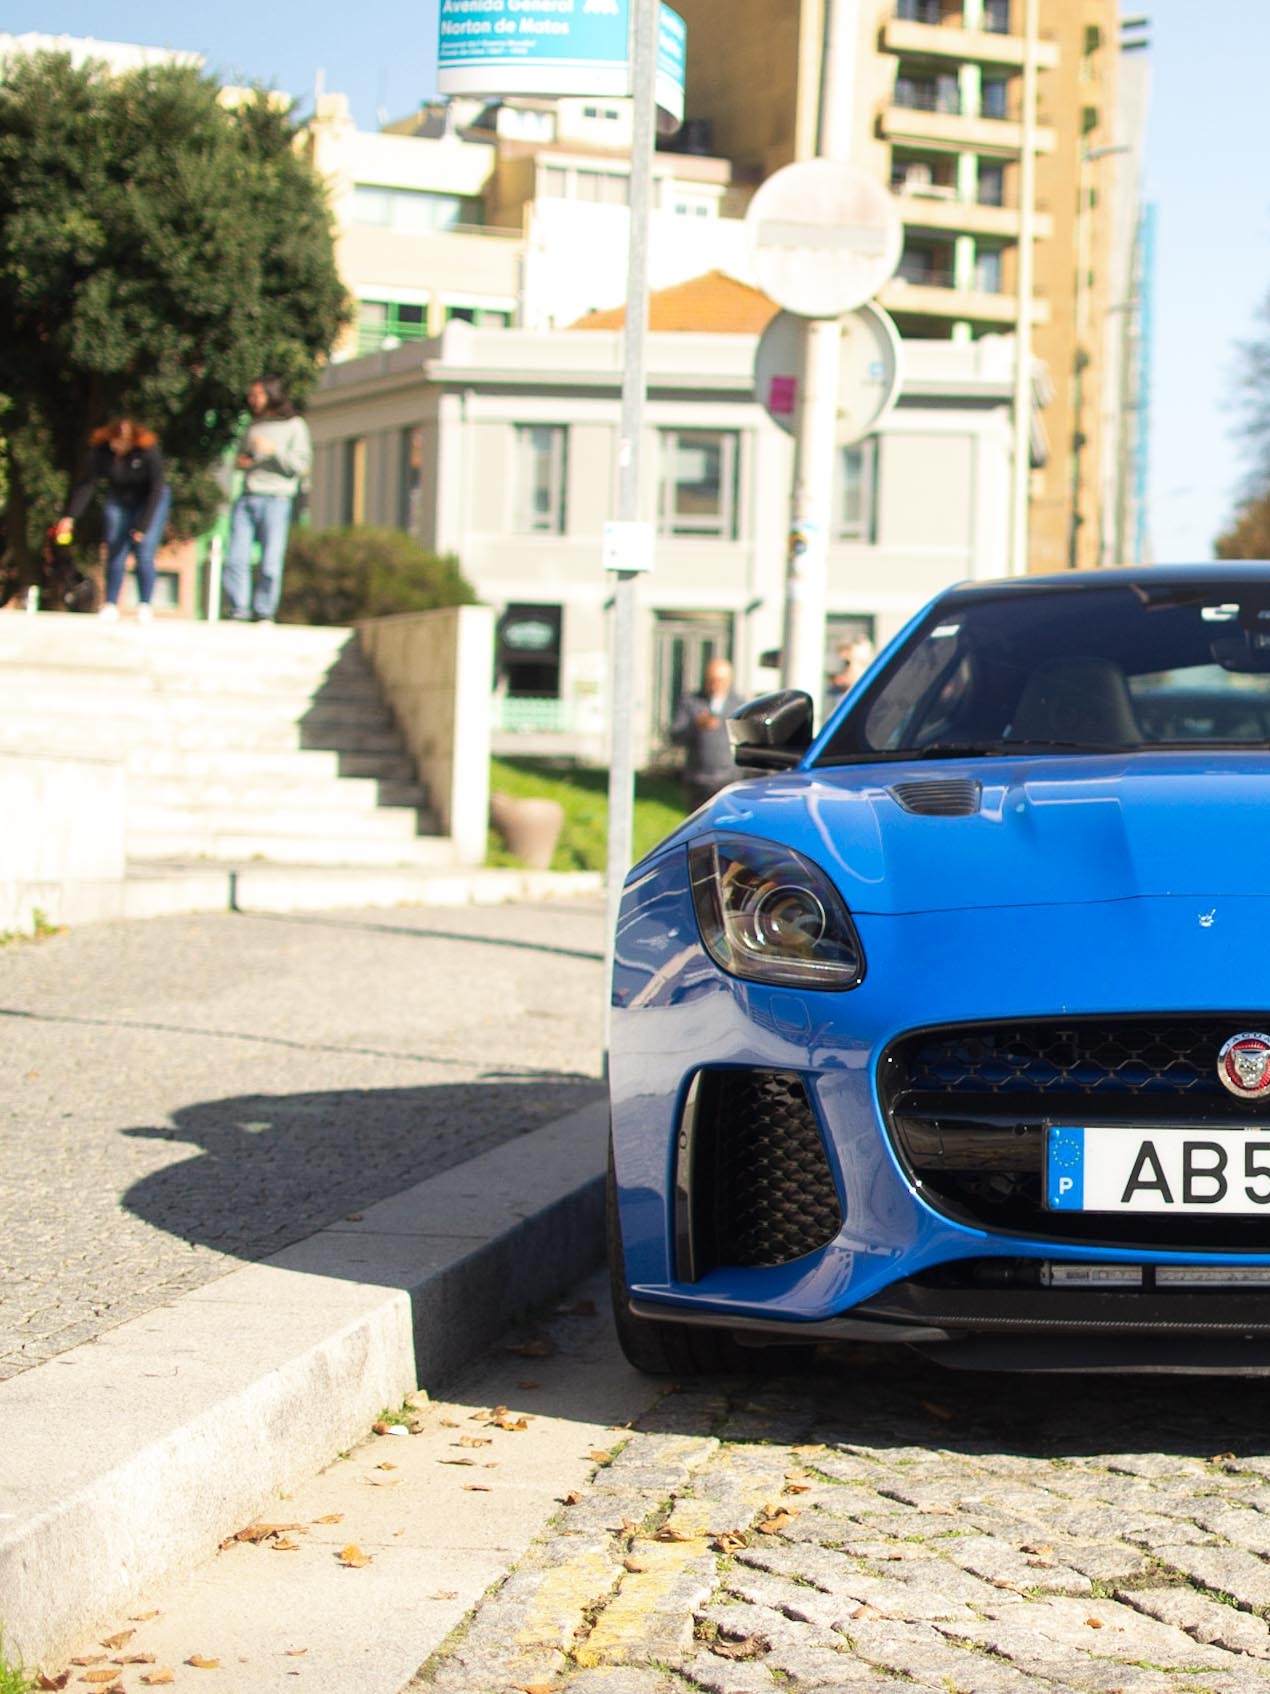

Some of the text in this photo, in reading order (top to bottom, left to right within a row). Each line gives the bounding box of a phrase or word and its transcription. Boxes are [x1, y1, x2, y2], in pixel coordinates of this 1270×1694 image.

[442, 0, 574, 13] Avenida General
[441, 17, 570, 35] Norton de Matos
[1059, 1178, 1073, 1195] P
